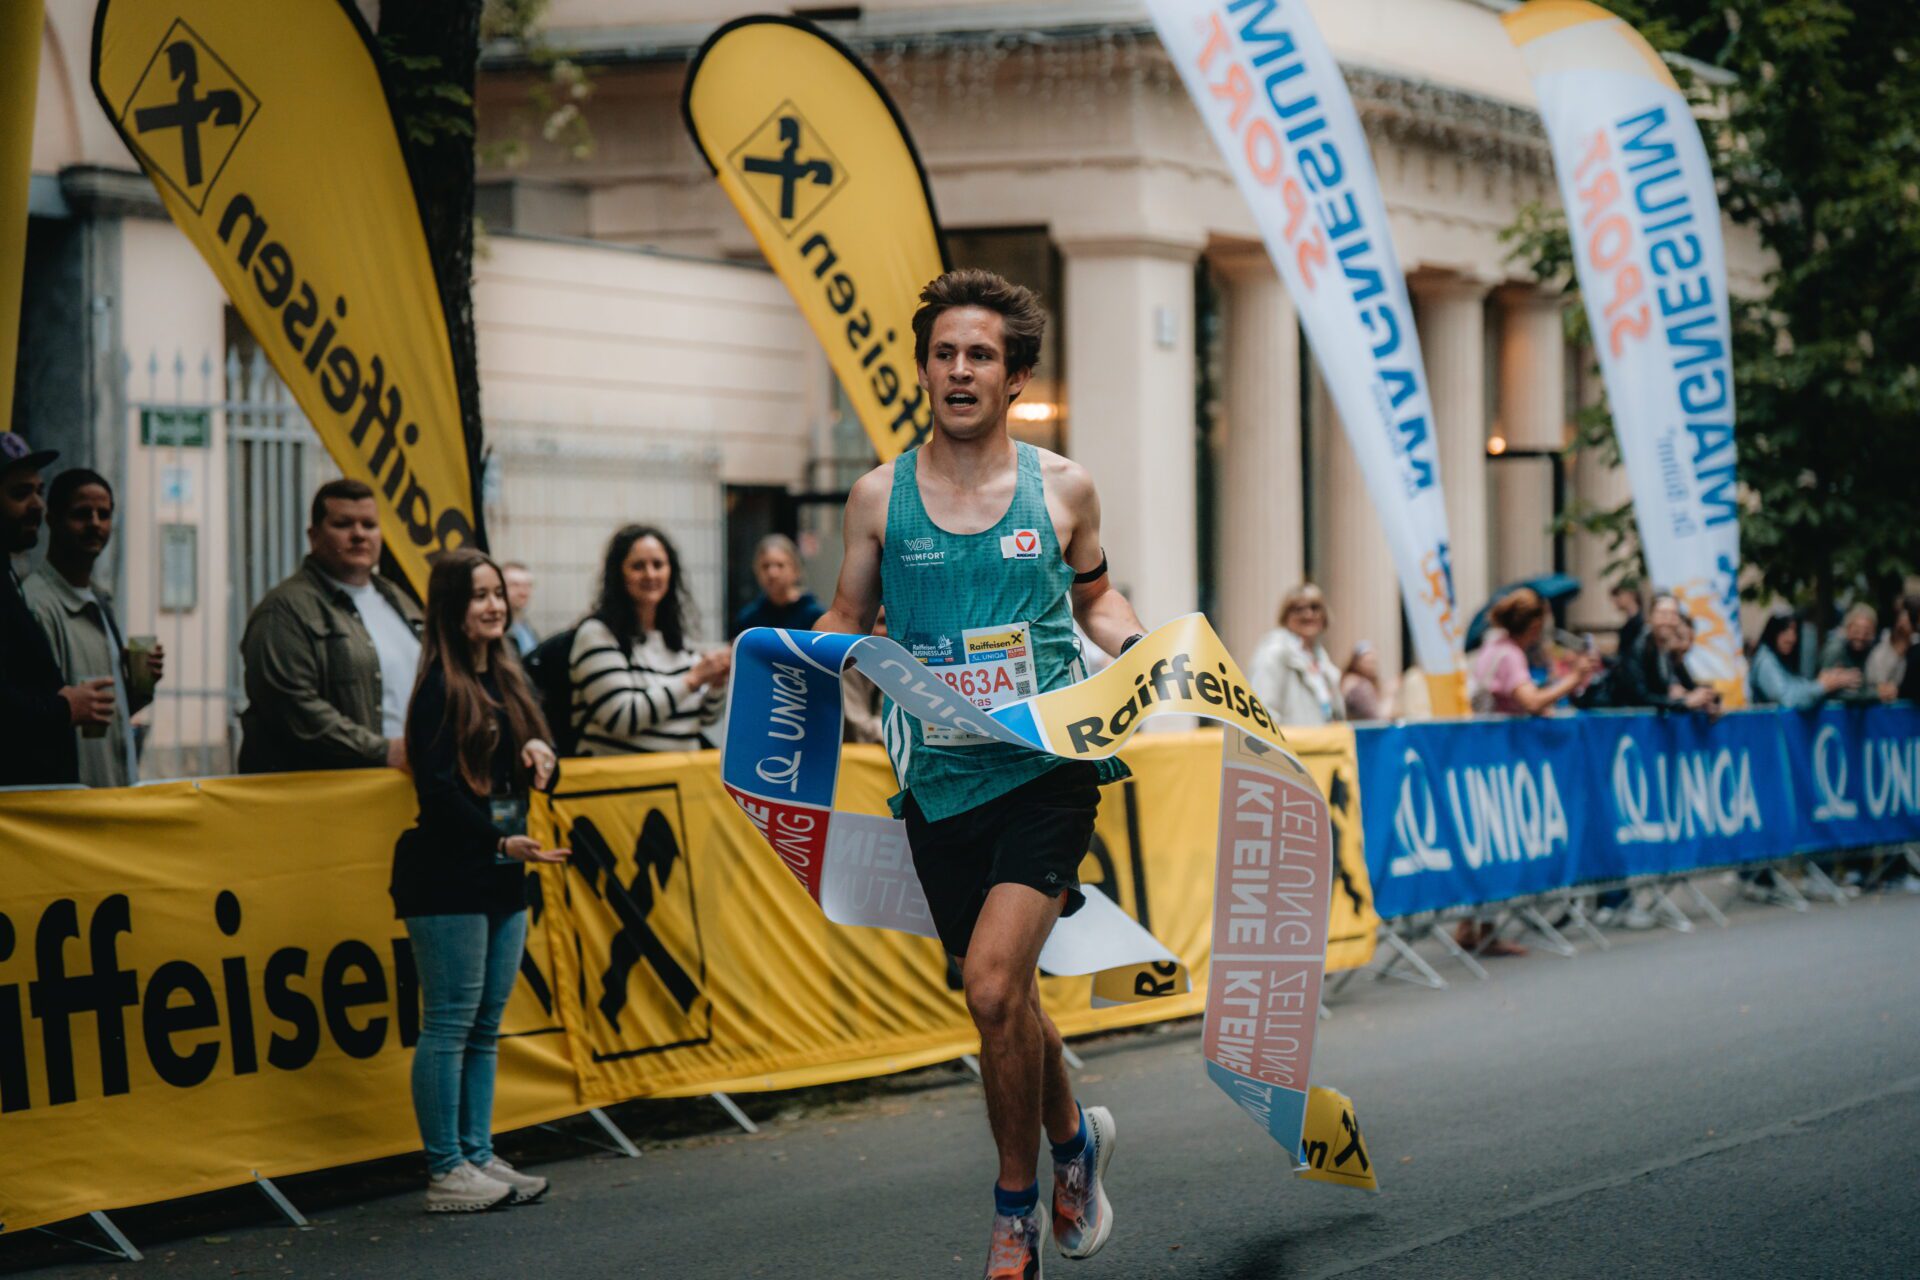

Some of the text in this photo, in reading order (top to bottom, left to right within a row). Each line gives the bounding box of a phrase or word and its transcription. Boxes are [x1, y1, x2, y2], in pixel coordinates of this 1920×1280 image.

[934, 666, 1014, 696] 863A
[969, 640, 1011, 651] Raiffeisen
[768, 661, 808, 741] UNIQA
[1066, 653, 1288, 754] Raiffeisen
[1446, 759, 1569, 870] UNIQA
